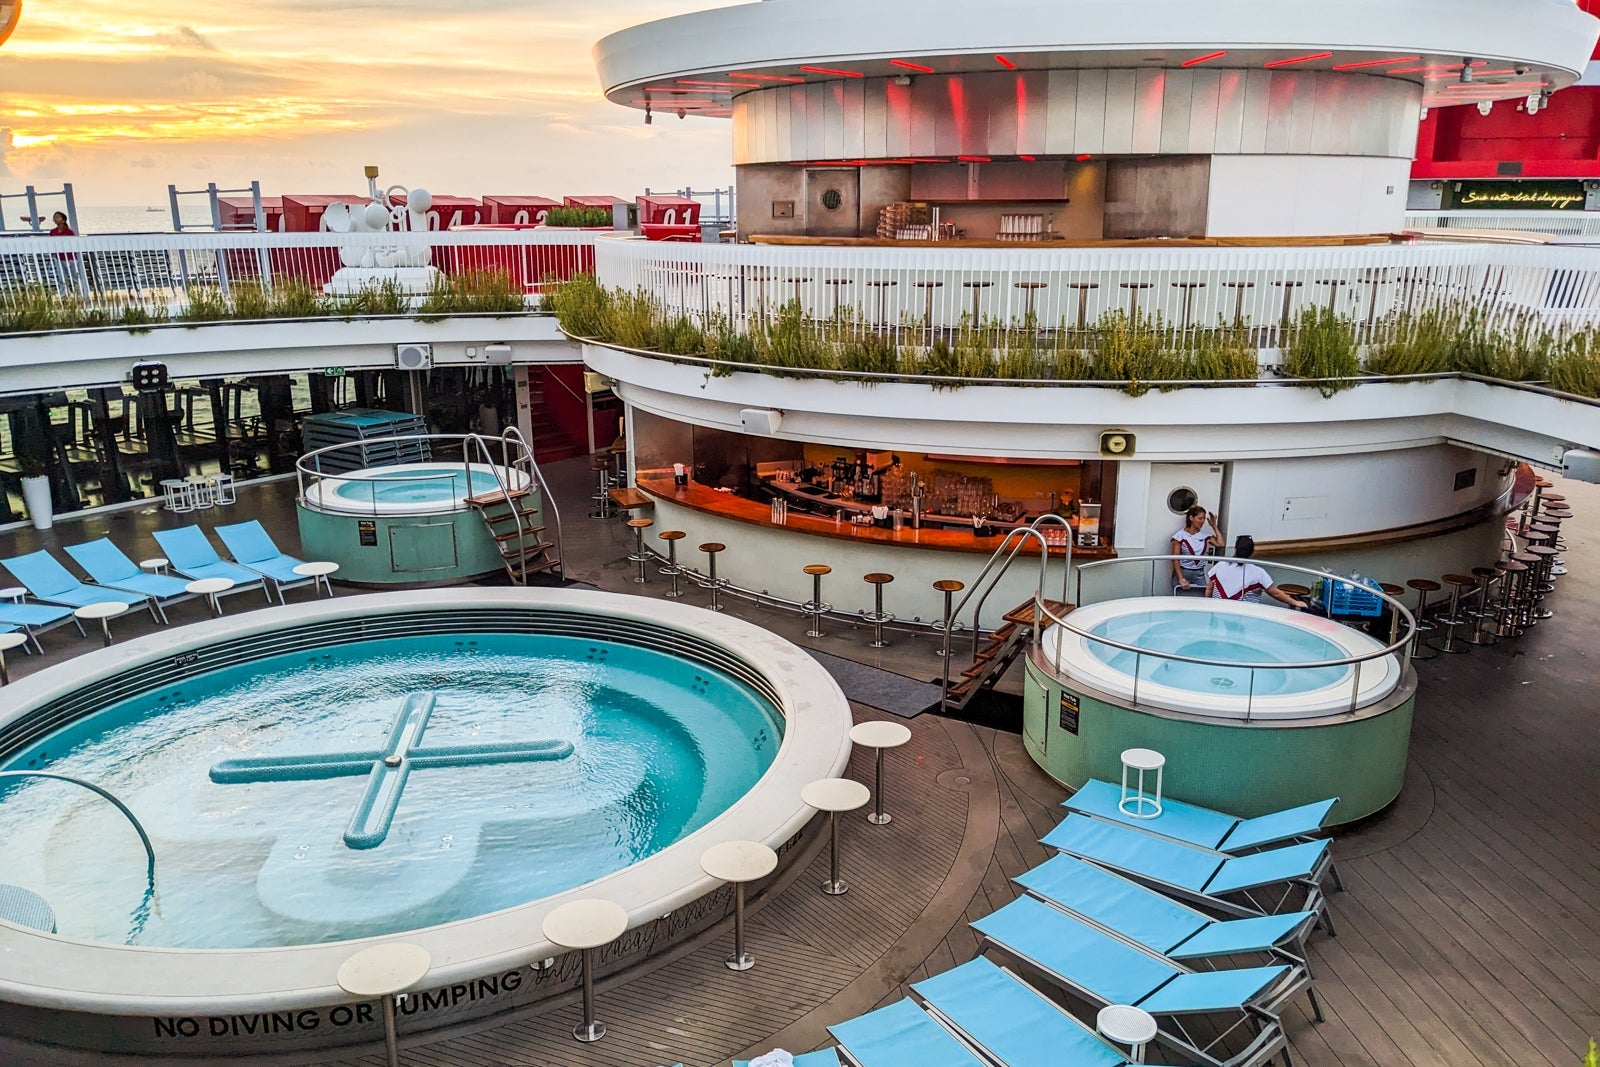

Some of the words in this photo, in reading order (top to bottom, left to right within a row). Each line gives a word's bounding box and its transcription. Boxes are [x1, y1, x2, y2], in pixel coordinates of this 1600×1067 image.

[153, 1016, 200, 1038] NO
[209, 1008, 321, 1036] DIVING
[328, 1002, 375, 1027] OR
